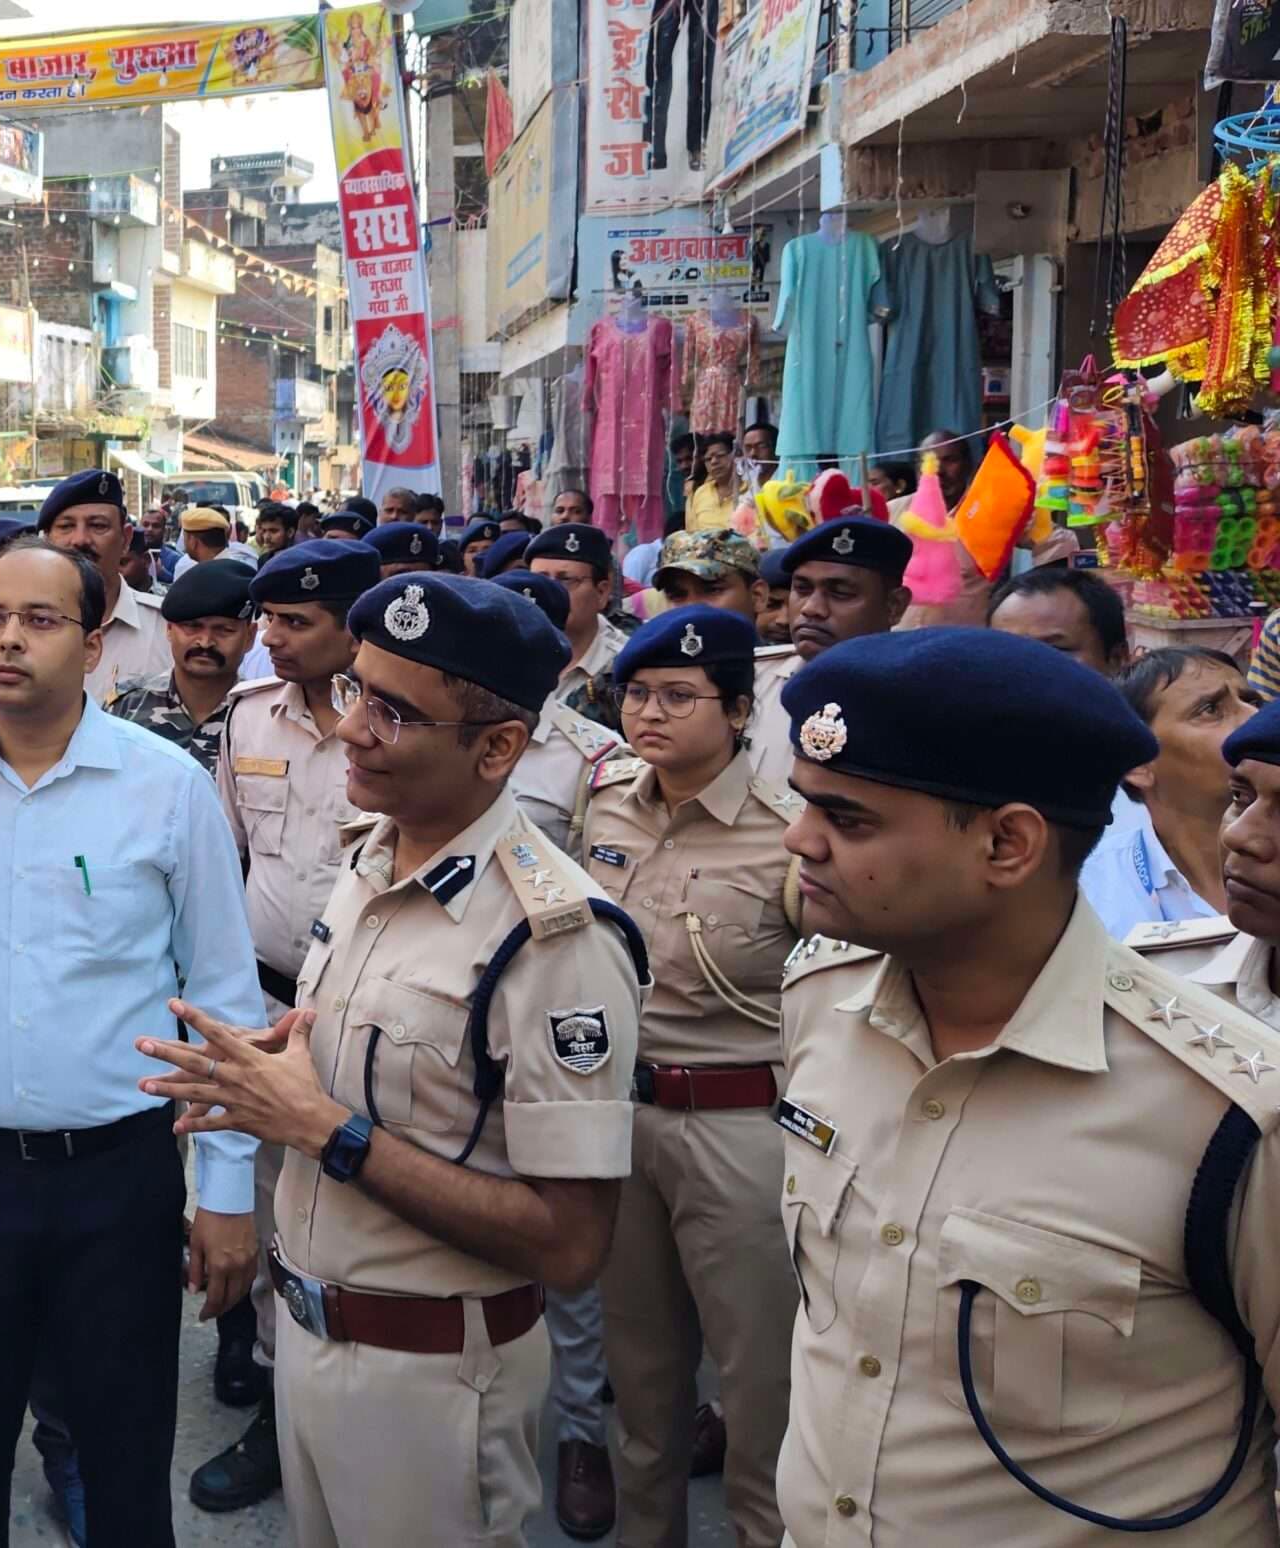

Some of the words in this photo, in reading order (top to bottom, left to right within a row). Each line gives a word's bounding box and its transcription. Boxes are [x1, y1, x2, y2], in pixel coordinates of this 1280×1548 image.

[22, 87, 61, 99] करता
[348, 194, 410, 252] संघ
[628, 236, 751, 265] अग्रवाल
[368, 300, 389, 315] गया
[392, 295, 408, 312] जी
[567, 1041, 596, 1055] बिहार
